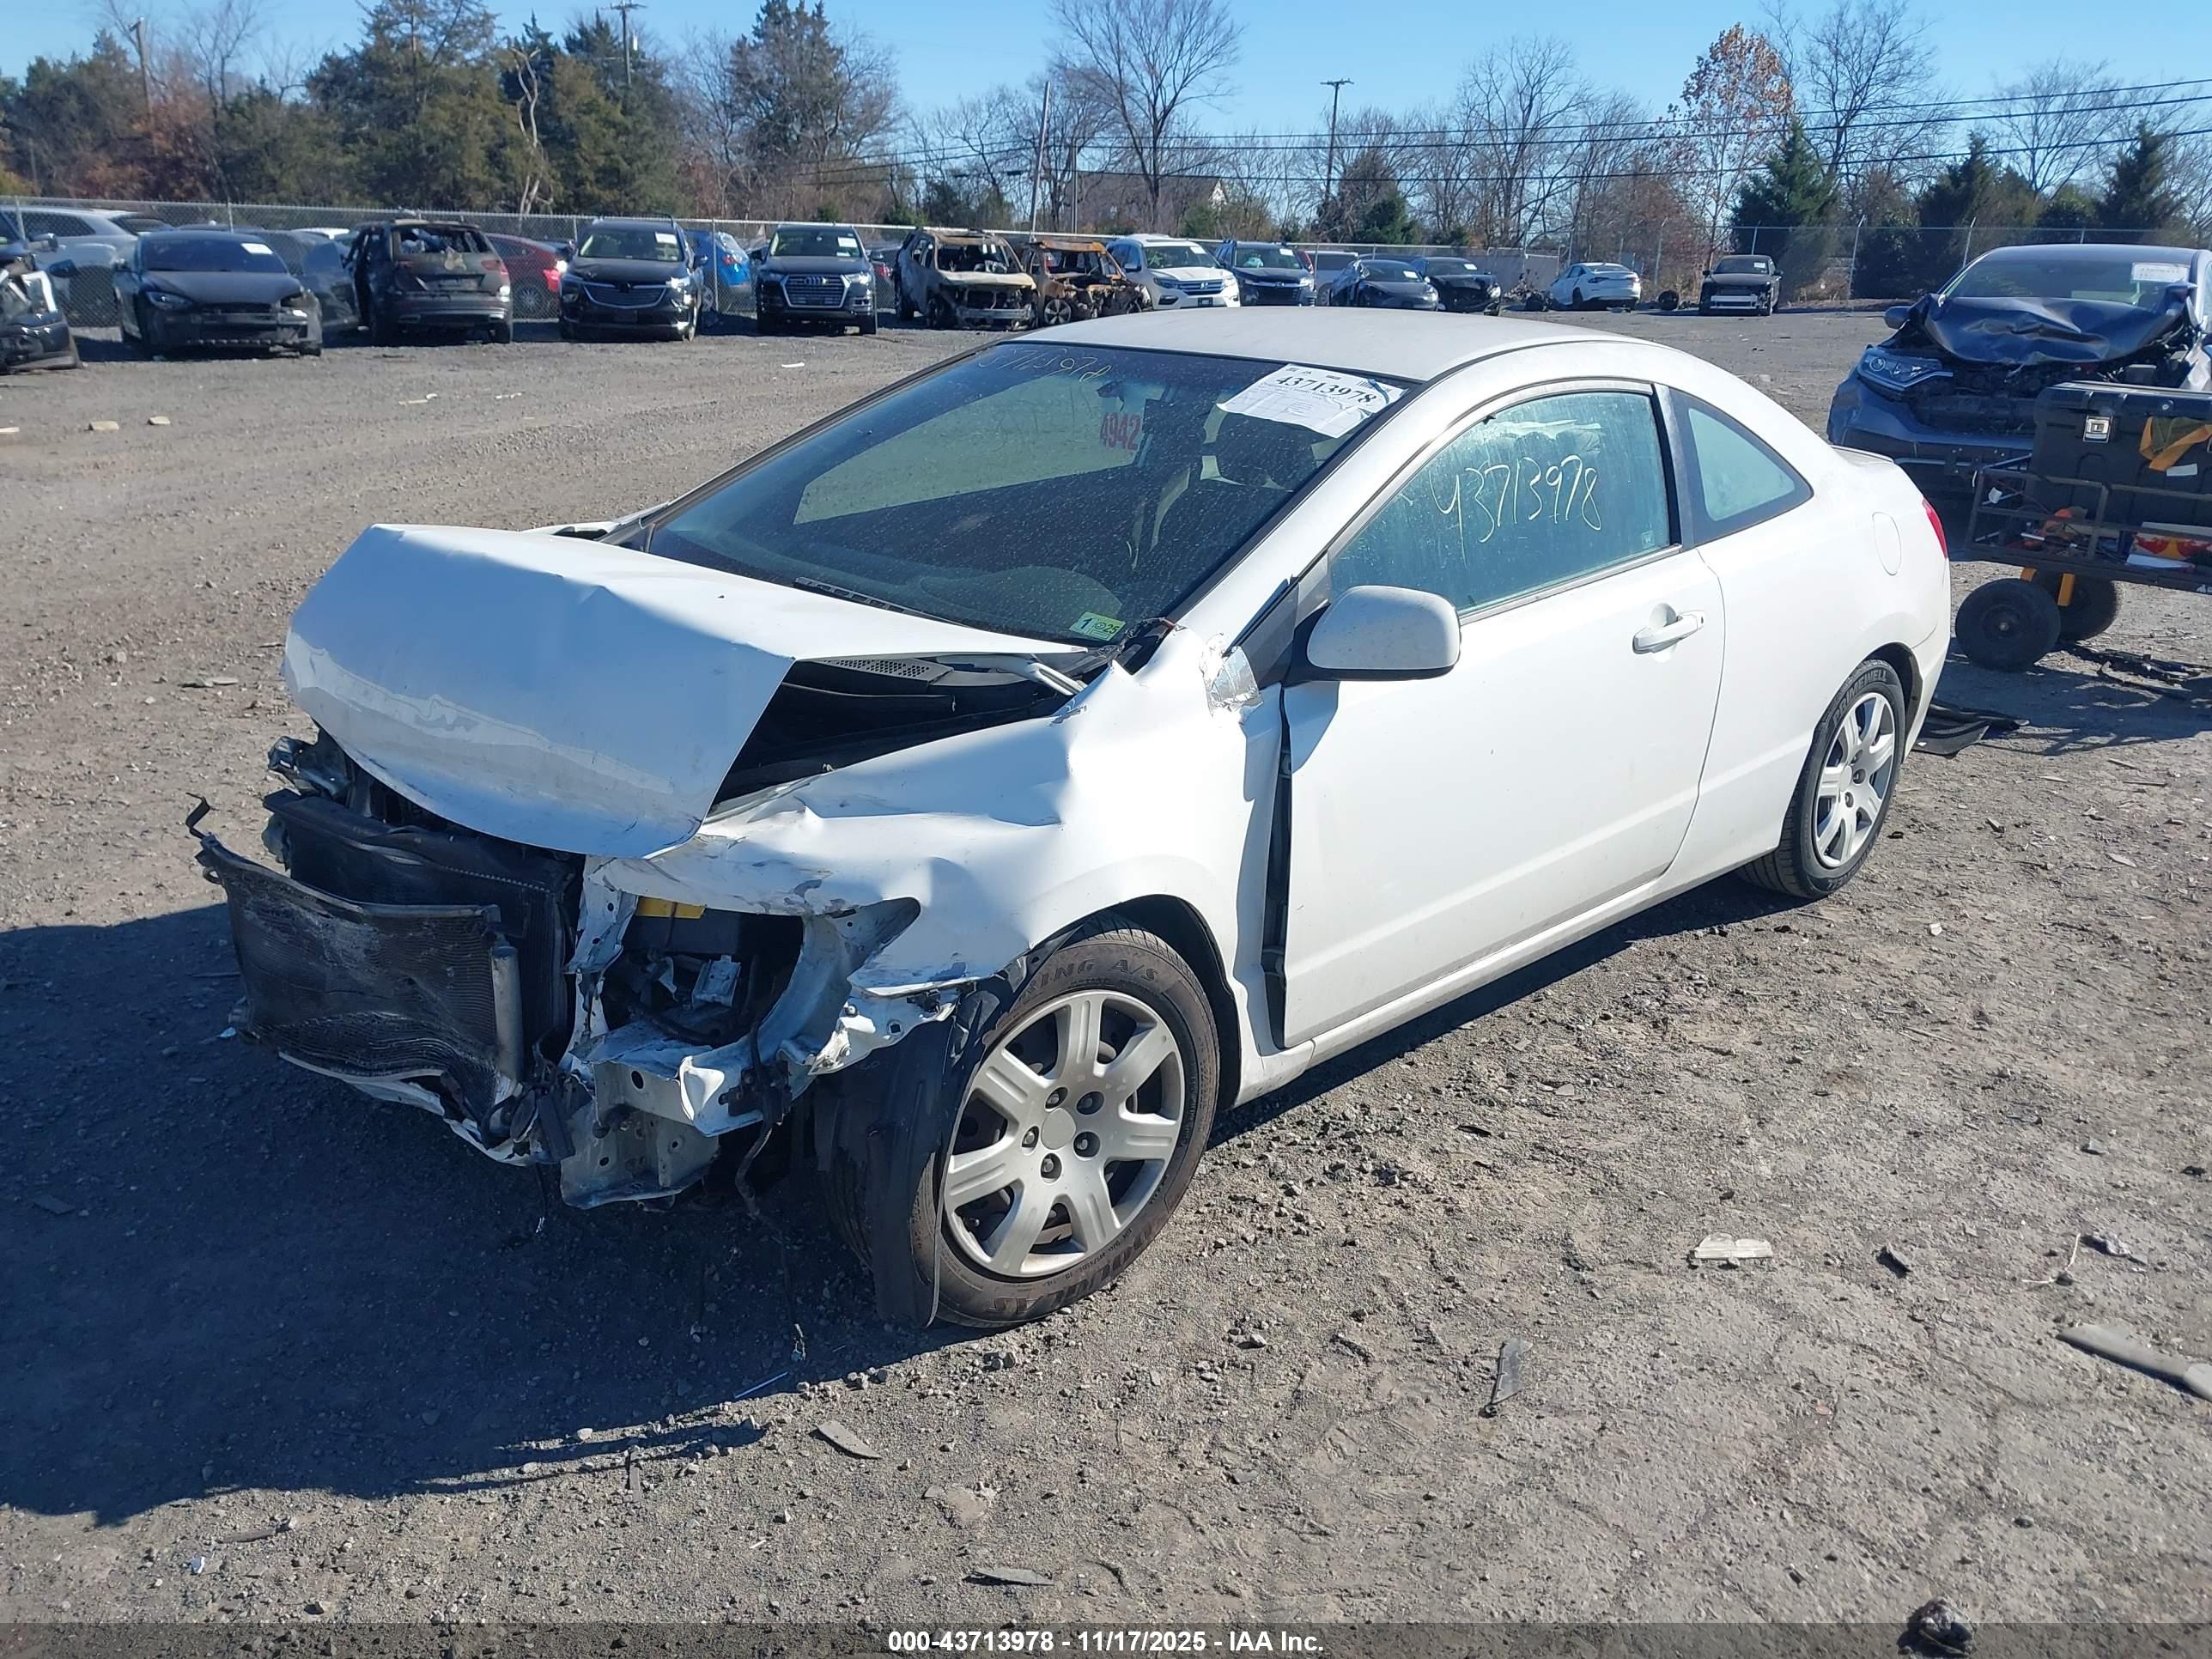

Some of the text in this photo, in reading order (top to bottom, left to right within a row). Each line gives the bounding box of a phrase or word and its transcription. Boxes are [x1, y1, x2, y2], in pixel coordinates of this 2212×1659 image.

[1275, 376, 1377, 403] 43713978
[1099, 412, 1141, 451] 4942
[1428, 454, 1602, 568] 43713978
[1080, 618, 1121, 635] 1 25
[1832, 669, 1887, 726] PRIMEWELL
